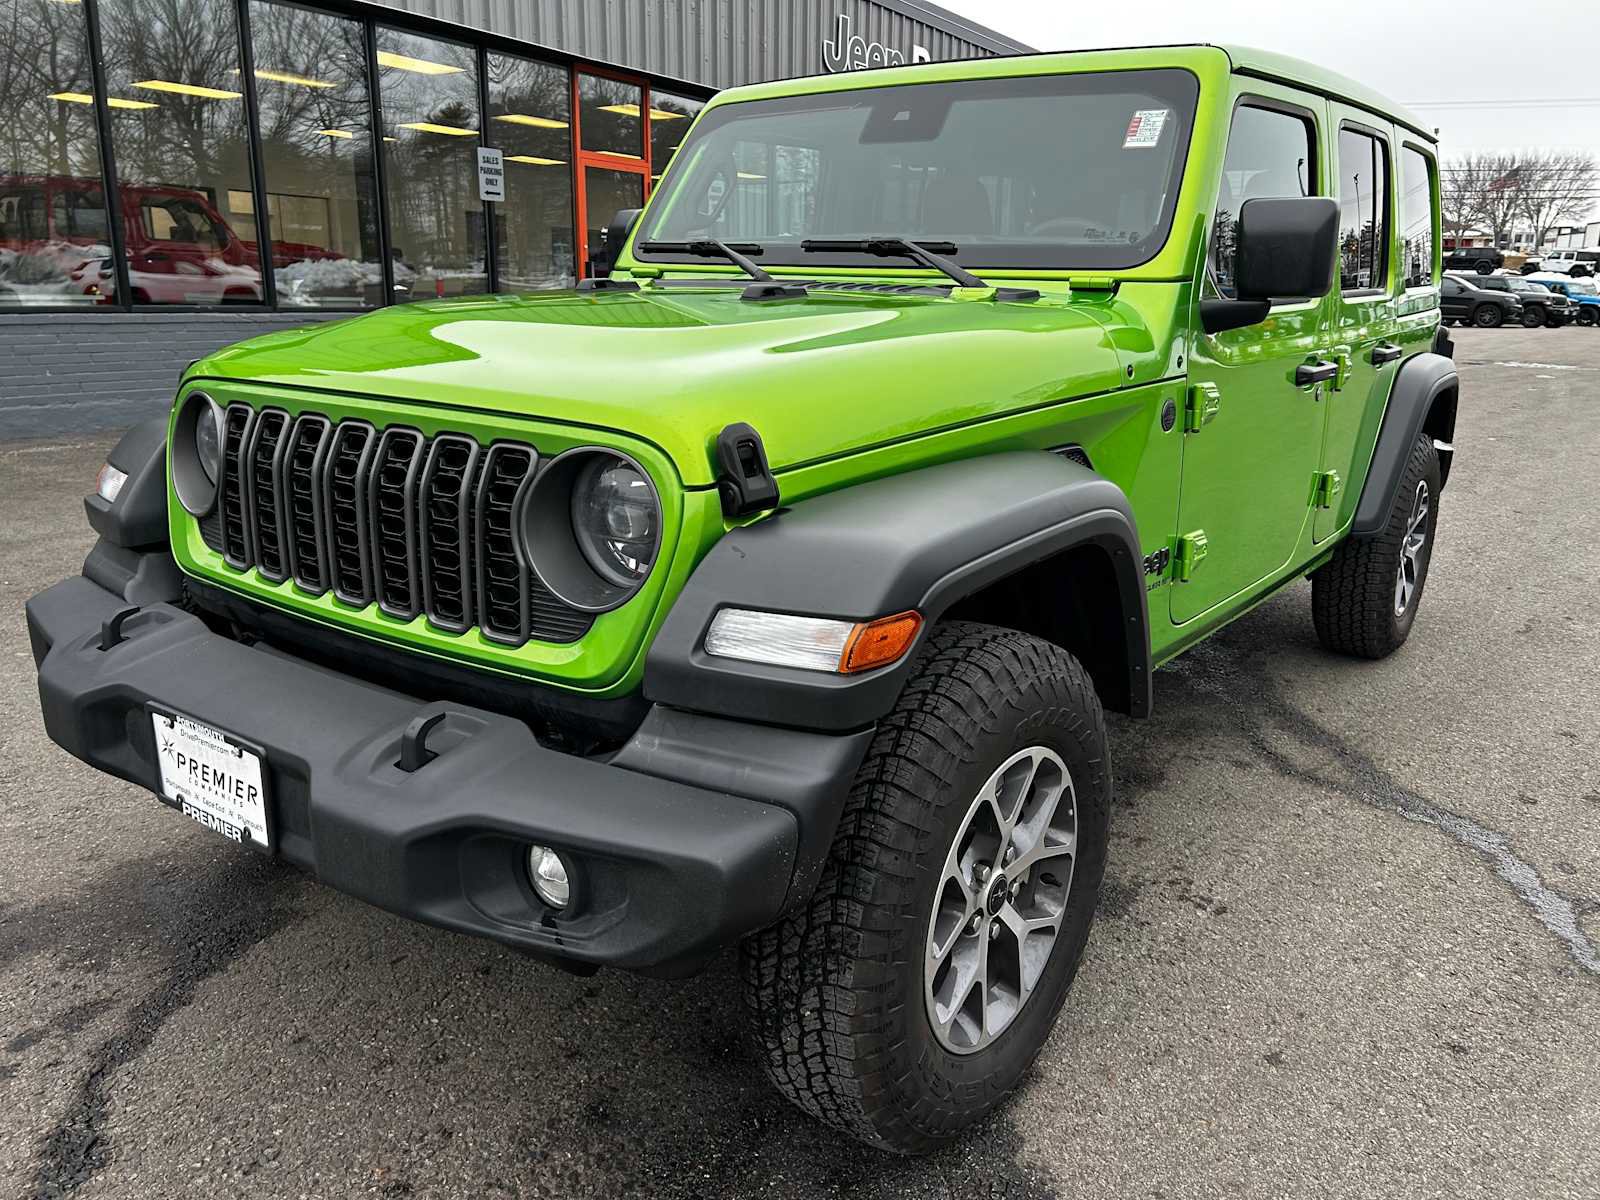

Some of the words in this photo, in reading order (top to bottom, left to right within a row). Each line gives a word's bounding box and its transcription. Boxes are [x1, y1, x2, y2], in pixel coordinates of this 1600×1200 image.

[480, 167, 503, 176] PARKING
[482, 156, 499, 165] SALES
[485, 178, 498, 186] ONLY
[1143, 547, 1169, 576] eep
[176, 716, 225, 742] PORTSMOUTH
[177, 752, 258, 806] PREMIER
[188, 776, 247, 808] COMPANIES
[182, 801, 243, 843] PREMIER
